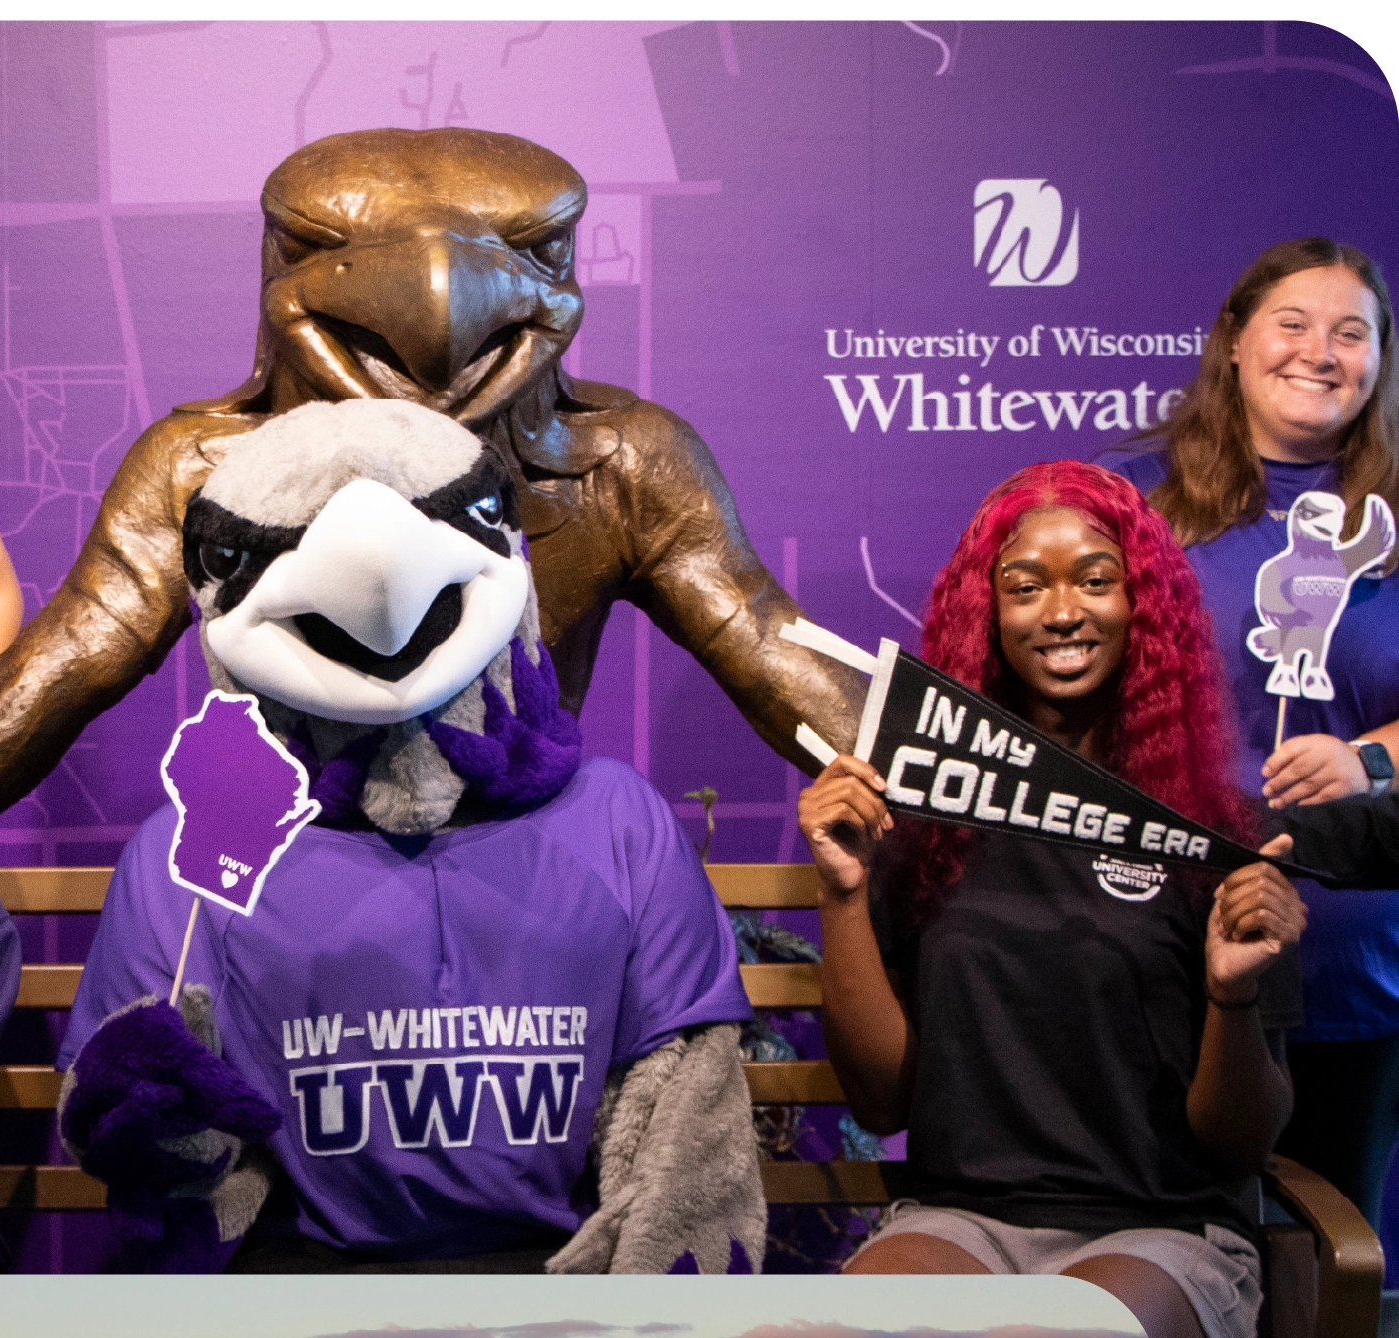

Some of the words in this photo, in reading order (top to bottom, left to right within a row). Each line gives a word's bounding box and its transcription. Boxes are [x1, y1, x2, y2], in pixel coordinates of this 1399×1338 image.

[824, 328, 1001, 368] University
[1007, 323, 1045, 358] of
[1050, 325, 1209, 357] Wisconsi
[824, 372, 1189, 433] Whitewate
[915, 686, 967, 745] IN
[969, 717, 1037, 768] MY
[885, 745, 1132, 845] COLLEGE
[1139, 820, 1211, 861] ERA
[218, 853, 254, 877] UWW
[1092, 860, 1169, 884] UNIVERSITY
[1106, 872, 1151, 890] CENTER
[281, 1005, 589, 1060] UW-WHITEWATER
[289, 1054, 585, 1157] UWW
